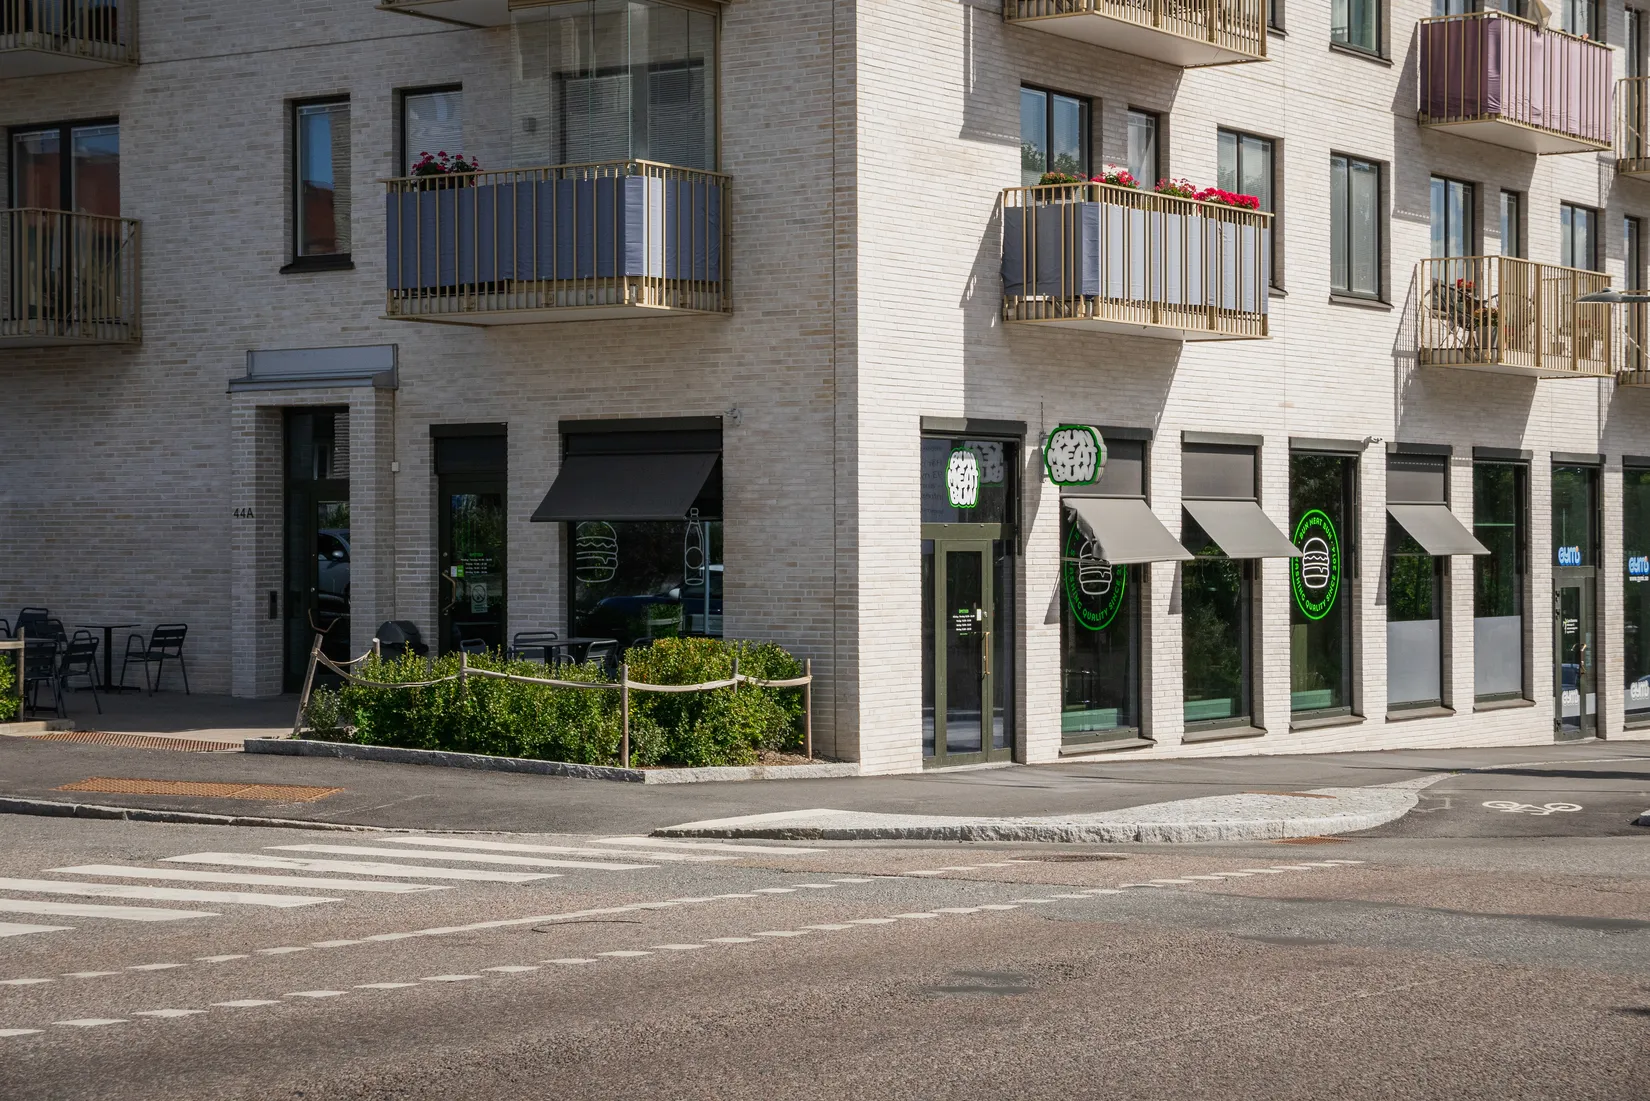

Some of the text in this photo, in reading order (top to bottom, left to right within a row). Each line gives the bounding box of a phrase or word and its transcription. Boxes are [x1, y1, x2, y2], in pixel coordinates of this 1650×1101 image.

[1051, 429, 1094, 449] BUN
[950, 451, 976, 470] BUN
[1047, 446, 1098, 467] MEAT
[948, 468, 978, 488] MEAT
[1051, 464, 1095, 482] BUN
[950, 486, 976, 505] BUN
[233, 507, 254, 519] 44A
[1300, 521, 1309, 540] BUN
[1082, 607, 1108, 622] QUALITY
[1305, 599, 1326, 612] QUALITY
